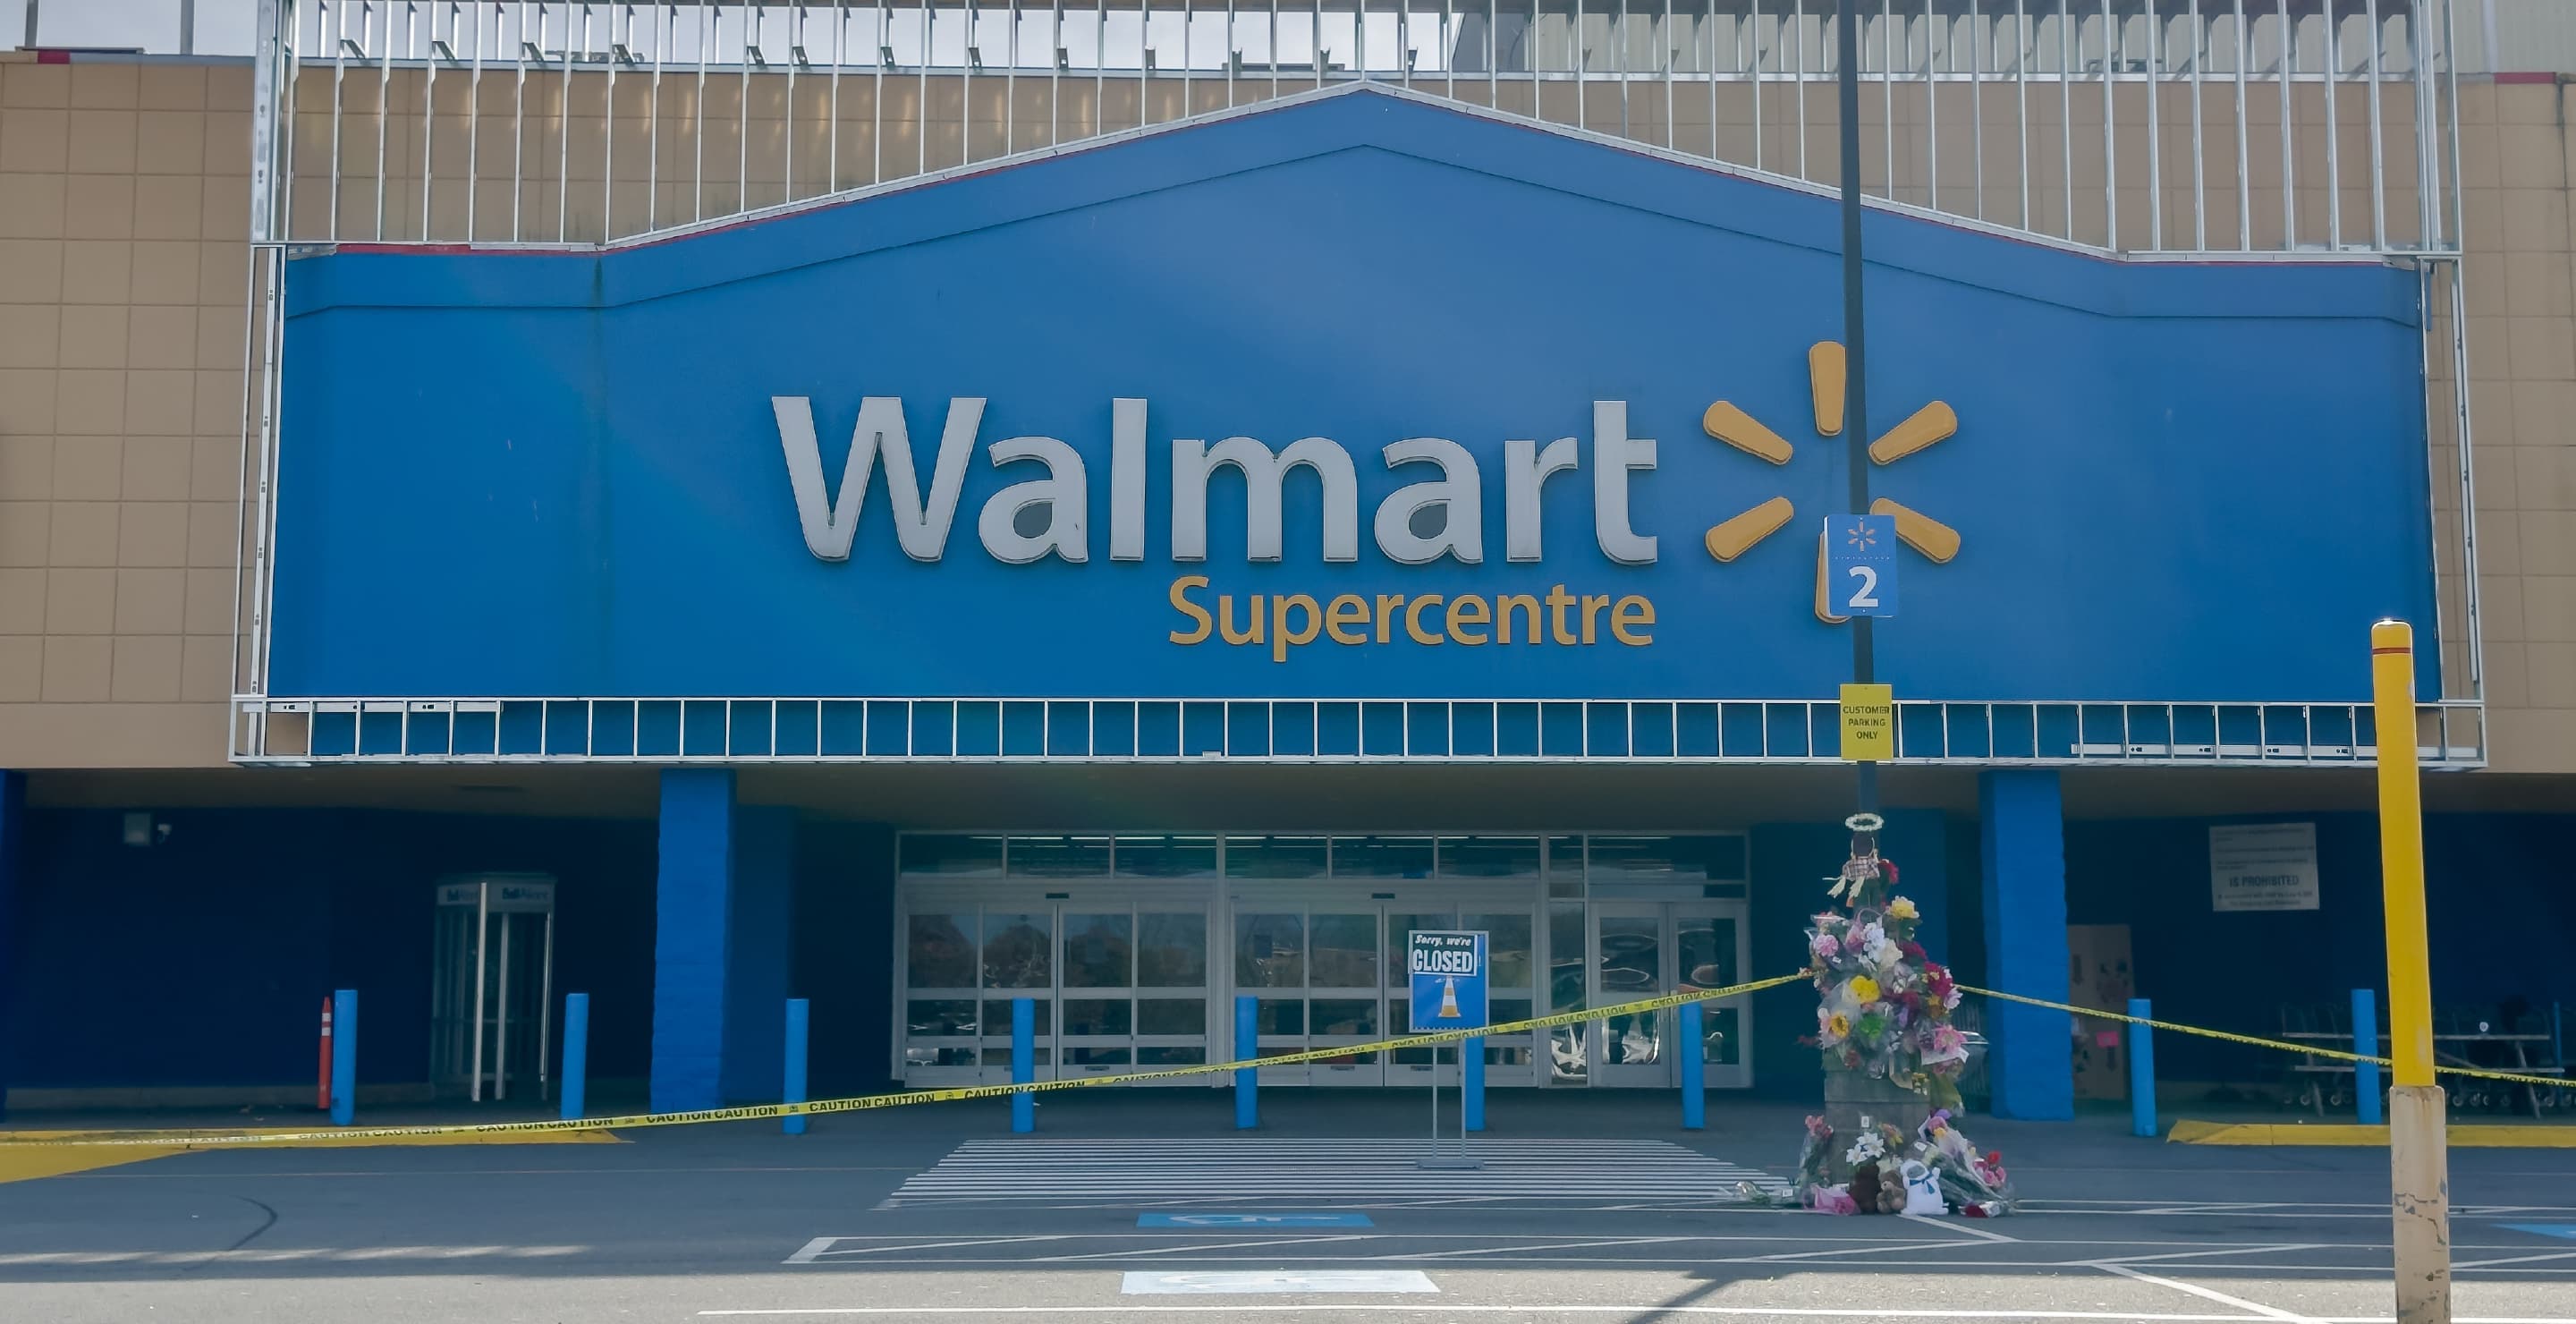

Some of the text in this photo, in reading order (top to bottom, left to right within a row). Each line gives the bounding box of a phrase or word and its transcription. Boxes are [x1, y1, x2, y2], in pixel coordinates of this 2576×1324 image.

[772, 395, 1657, 564] Walmart
[1849, 565, 1878, 607] 2
[1168, 574, 1657, 663] Supercentre
[1843, 706, 1890, 714] CUSTOMER
[1848, 718, 1885, 726] PARKING
[1856, 731, 1878, 740] ONLY
[2241, 875, 2299, 887] PROHIBITED
[1415, 935, 1471, 946] Sorry, we're
[1413, 949, 1473, 972] CLOSED
[714, 1107, 777, 1119] CAUTION
[809, 1099, 871, 1112] CAUTION
[874, 1093, 935, 1107] CAUTION
[965, 1086, 1023, 1099] CAUTION
